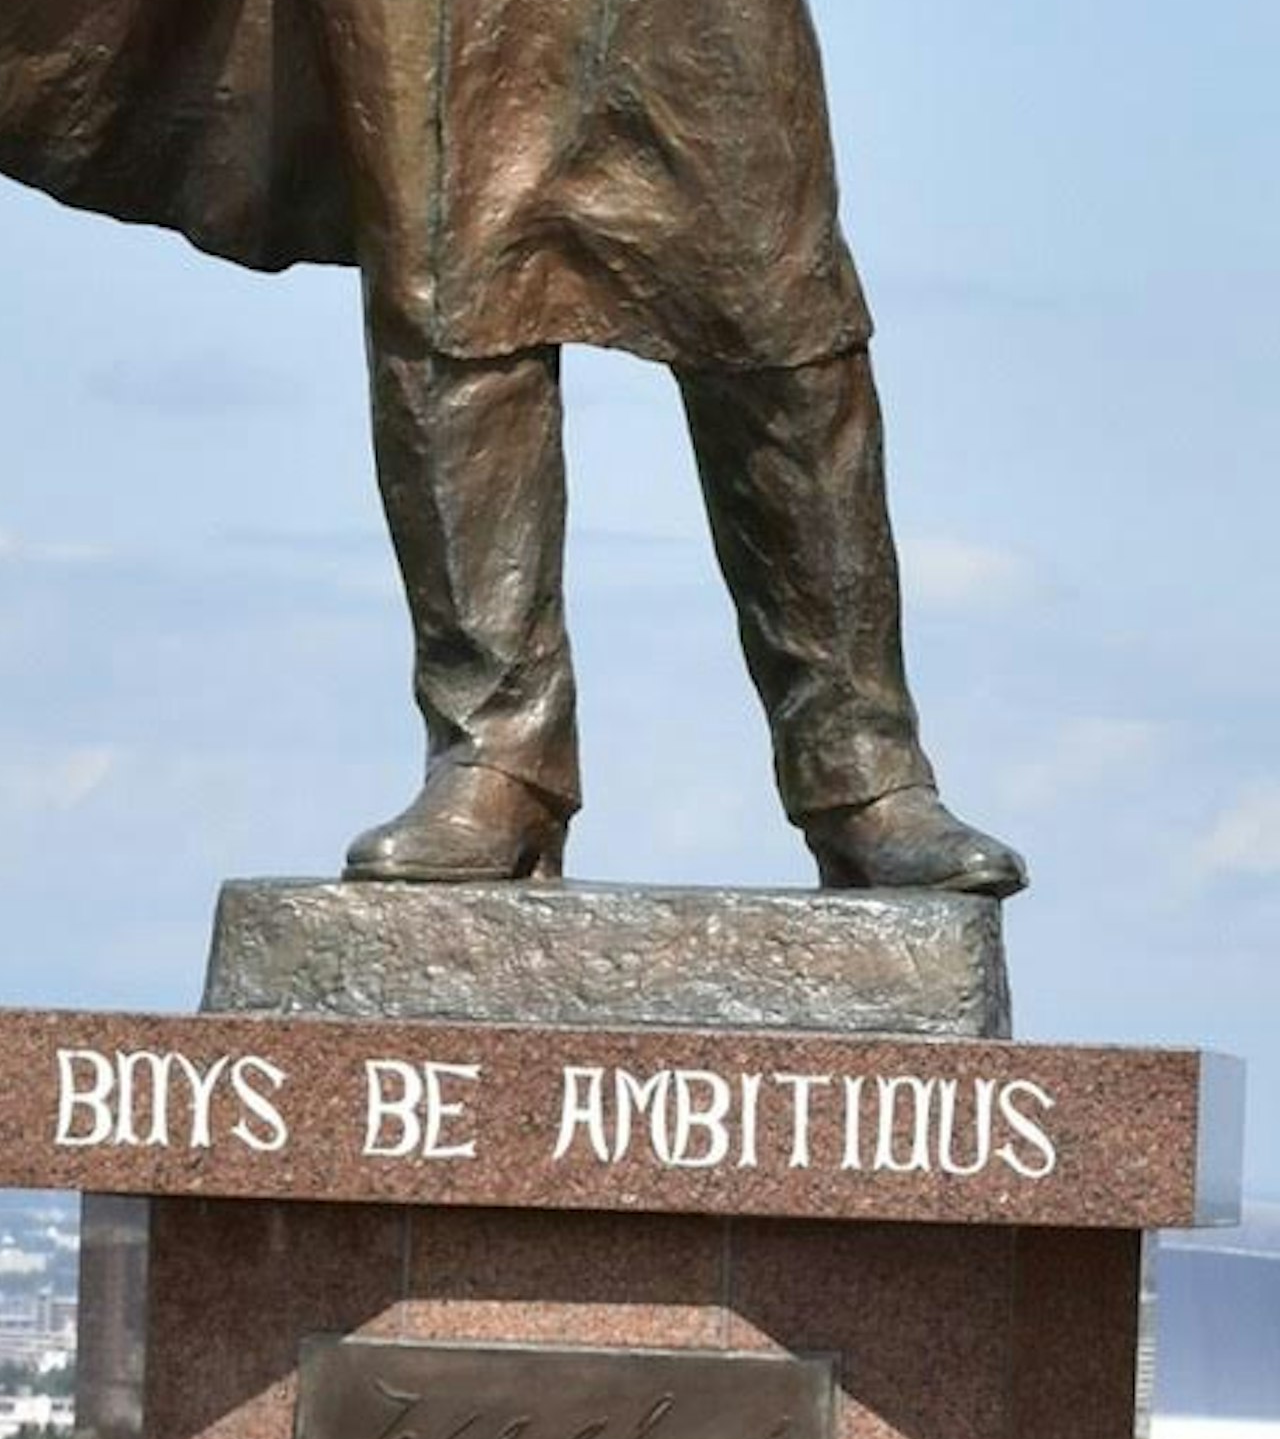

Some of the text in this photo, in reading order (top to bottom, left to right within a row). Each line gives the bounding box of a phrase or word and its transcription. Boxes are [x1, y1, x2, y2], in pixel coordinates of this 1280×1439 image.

[54, 1049, 1057, 1180] BOYS BE AMBITIOUS
